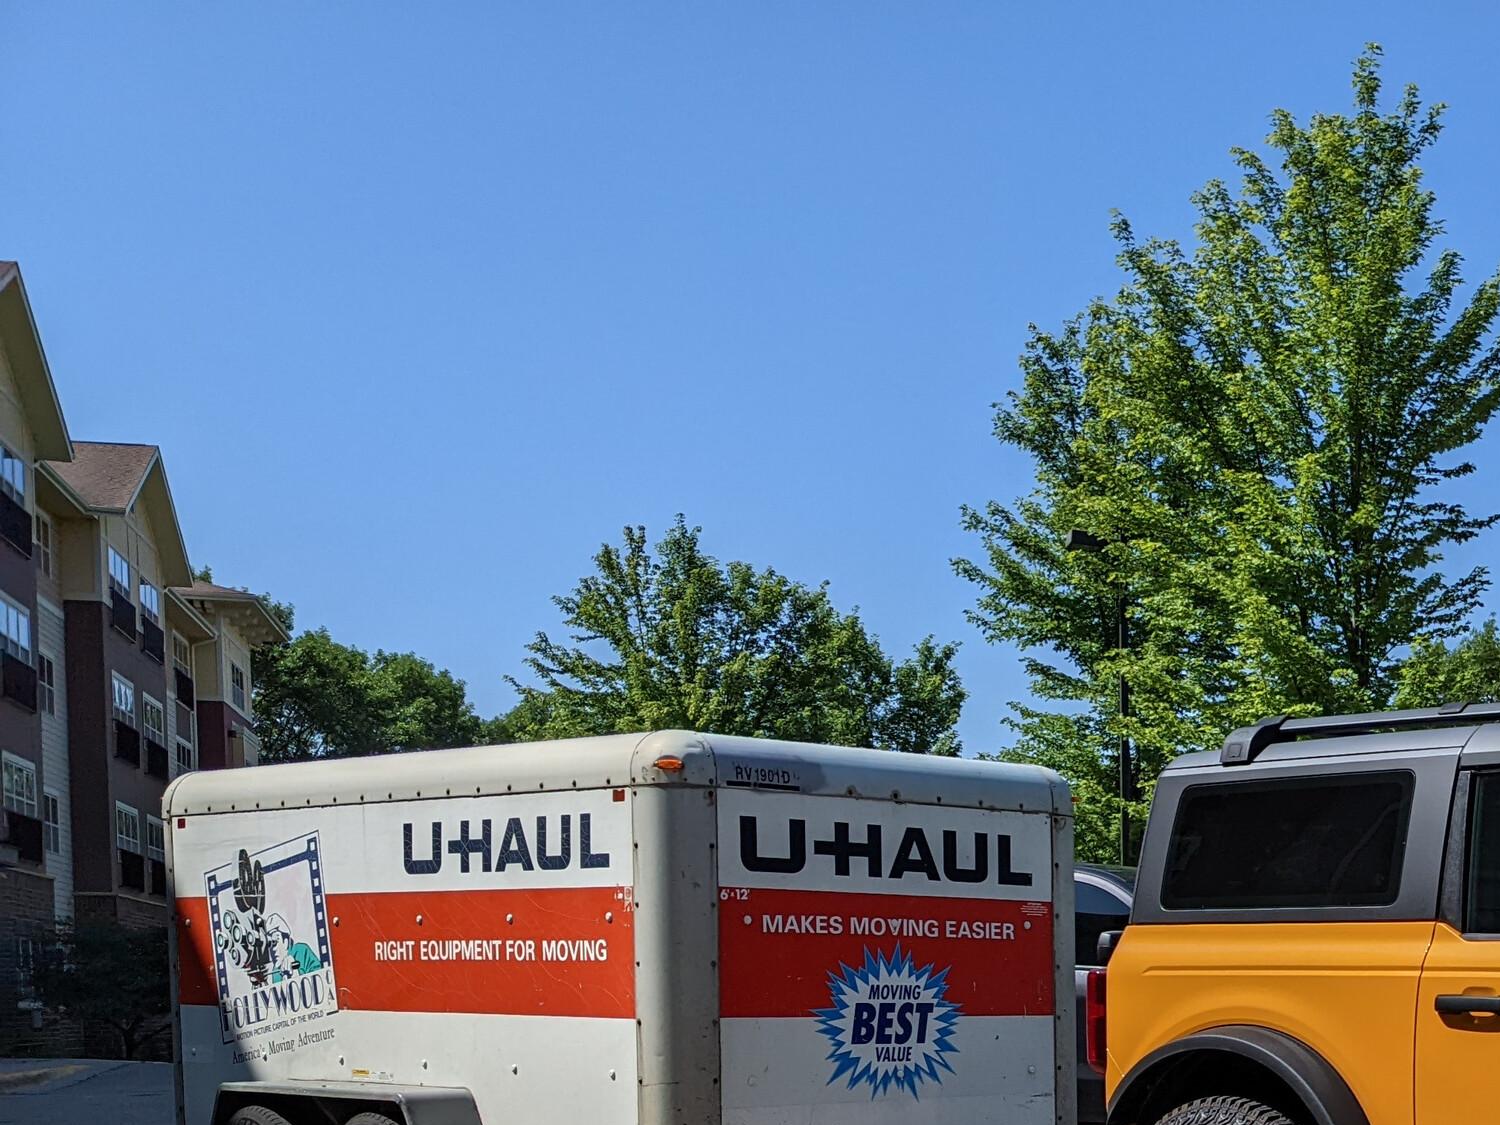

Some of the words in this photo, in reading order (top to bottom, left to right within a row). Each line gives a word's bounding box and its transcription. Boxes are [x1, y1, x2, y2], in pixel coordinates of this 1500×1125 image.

[403, 813, 610, 875] U-HAUL
[739, 815, 1033, 886] U-HAUL
[762, 914, 843, 934] MAKES
[850, 917, 939, 937] MOVING
[945, 920, 1015, 940] EASIER
[375, 940, 415, 961] RIGHT
[420, 939, 502, 961] EQUIPMENT
[506, 940, 535, 961] FOR
[542, 939, 607, 961] MOVING
[221, 973, 325, 1032] HOLLYWOOD
[868, 984, 921, 1000] MOVING
[236, 1031, 254, 1040] MOTION
[254, 1024, 271, 1037] PICTURE
[272, 1019, 290, 1031] CAPITAL
[290, 1017, 297, 1026] OF
[297, 1014, 307, 1024] THE
[307, 1010, 324, 1020] WORLD
[851, 1002, 934, 1045] BEST
[268, 1036, 295, 1056] Moving
[298, 1028, 335, 1048] Adventure
[876, 1046, 912, 1062] VALUE
